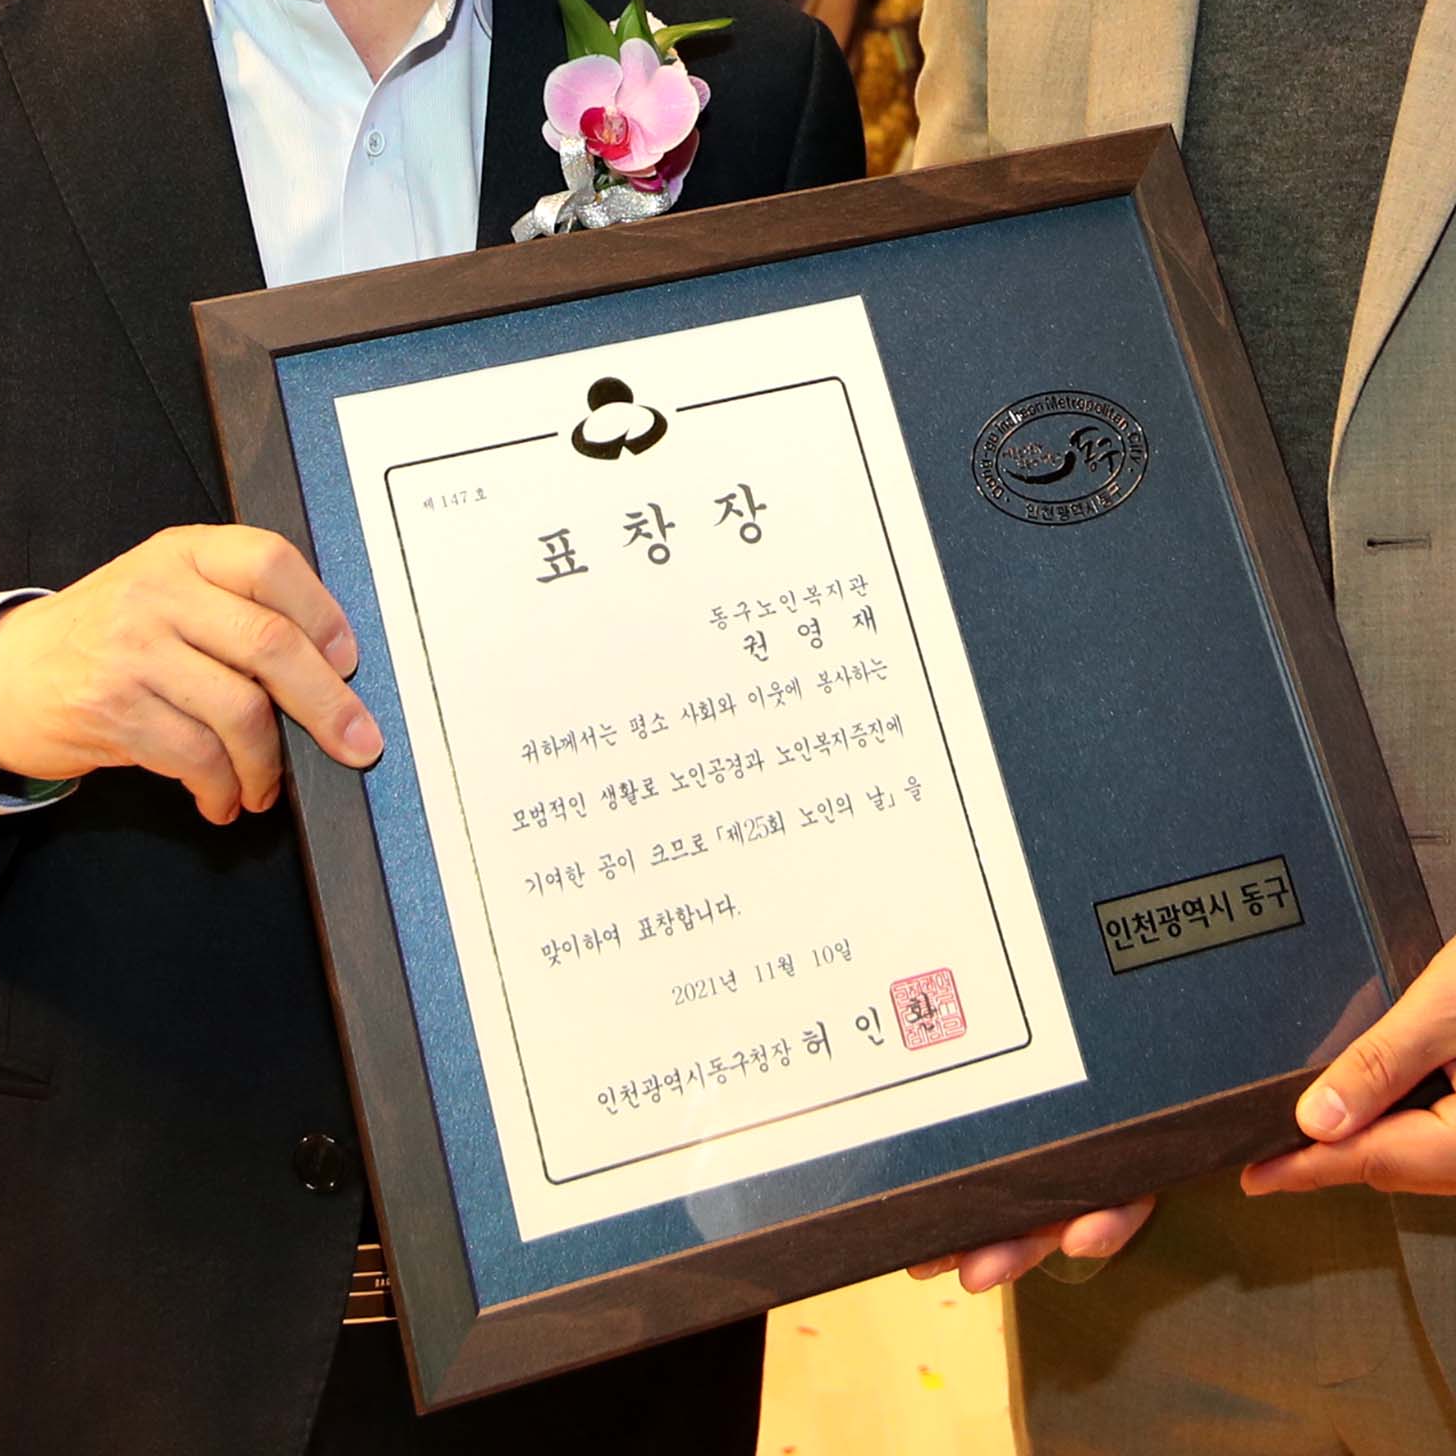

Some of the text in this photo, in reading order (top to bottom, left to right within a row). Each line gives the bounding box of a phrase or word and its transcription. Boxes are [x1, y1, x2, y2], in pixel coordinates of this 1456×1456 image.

[629, 712, 669, 740] 평소
[681, 692, 737, 725] 사회와
[747, 676, 802, 708] 이웃에
[816, 658, 888, 695] 봉사하는
[512, 713, 904, 832] 모범적인 생활로 노인공경과 노인복지증진에
[525, 861, 585, 896] 기여한
[597, 848, 636, 881] 공이
[650, 832, 709, 867] 크므로
[799, 792, 854, 828] 노인의
[540, 893, 741, 967] 맞이하여 표창합니다.
[1106, 876, 1289, 951] 인천광역시 동구
[671, 938, 853, 1006] 2021년 11월 10일
